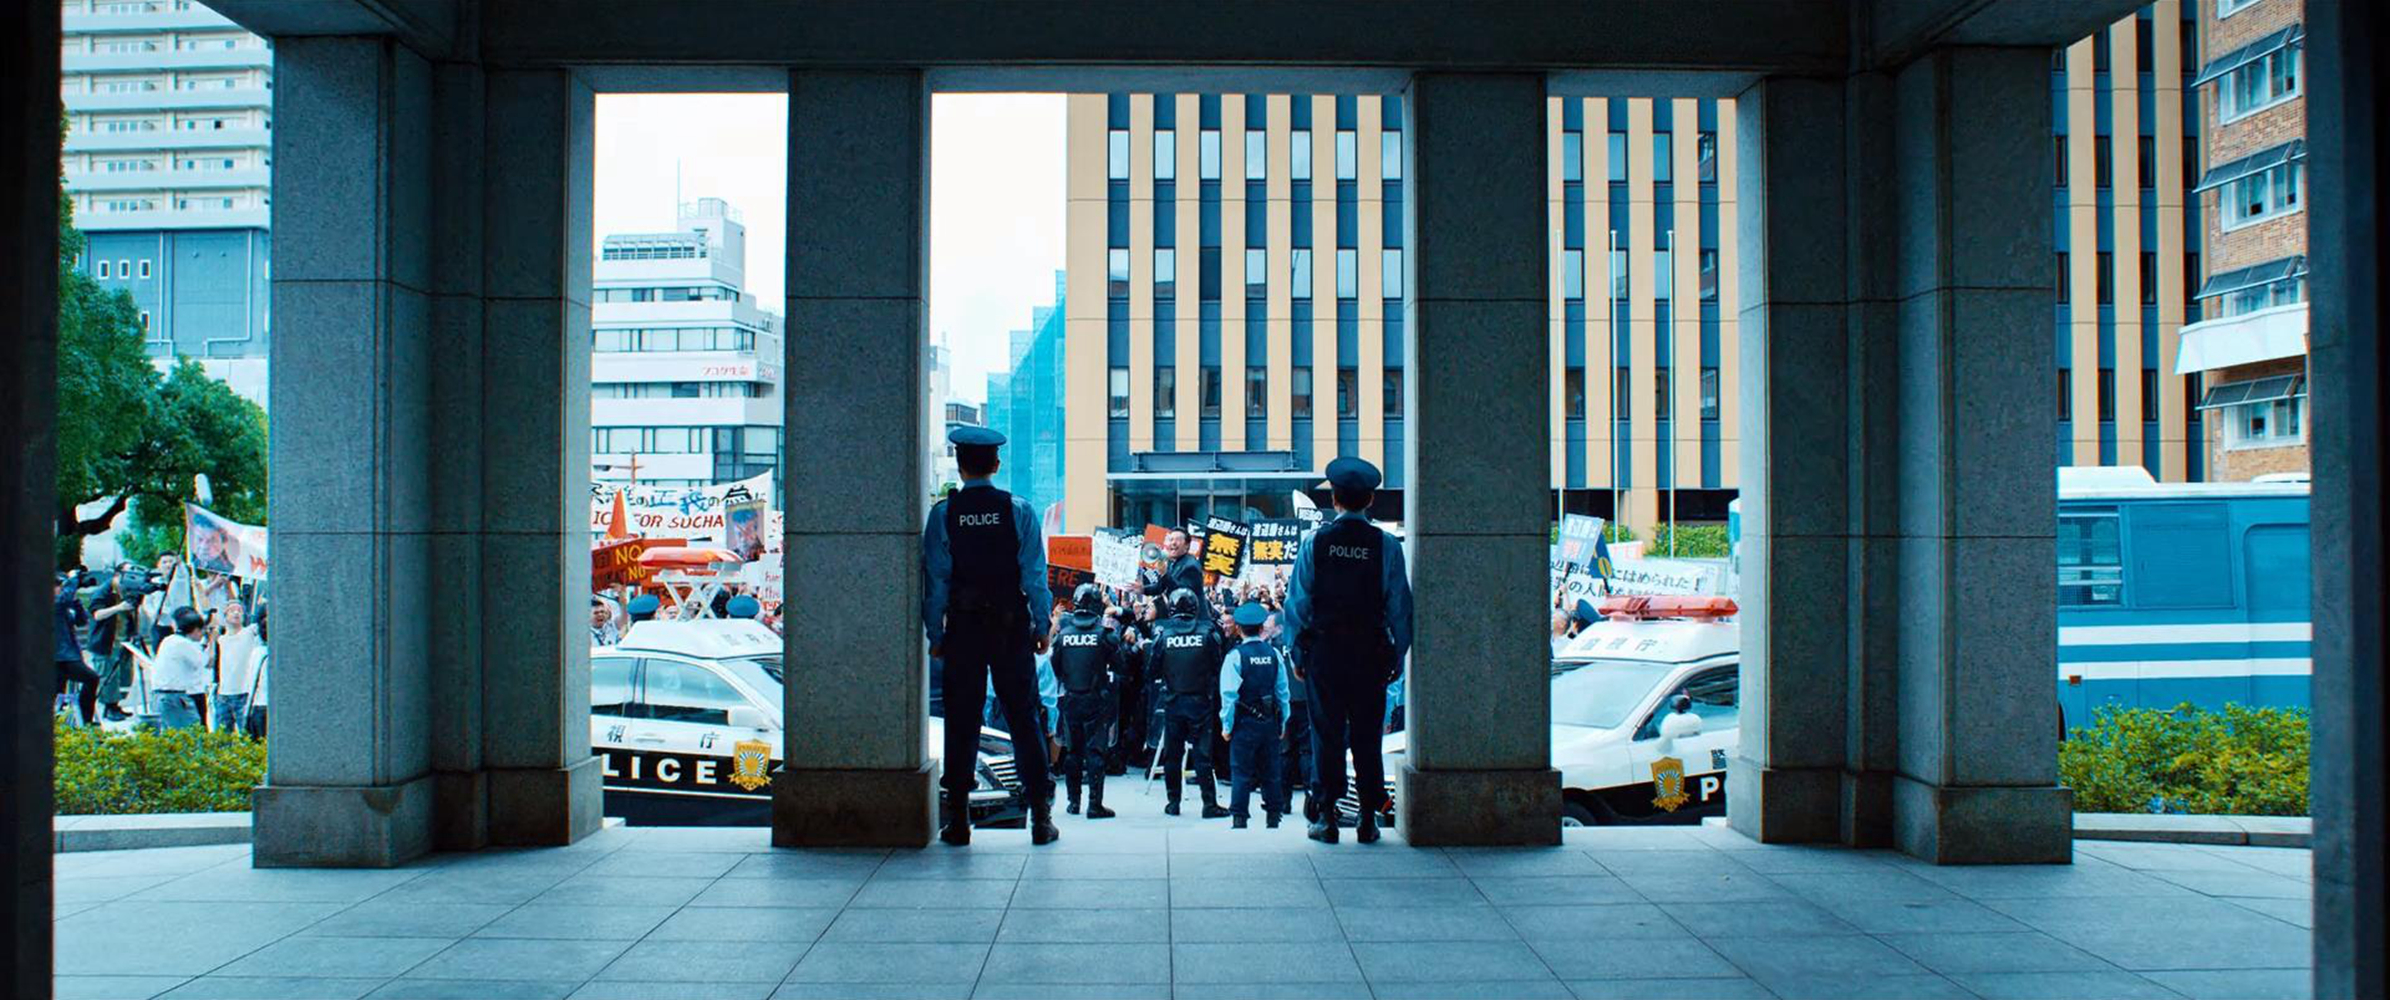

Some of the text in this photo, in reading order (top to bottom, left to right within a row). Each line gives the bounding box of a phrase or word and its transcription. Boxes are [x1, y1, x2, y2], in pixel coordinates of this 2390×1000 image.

[668, 515, 724, 529] SUCHA
[959, 513, 999, 526] POLICE
[615, 544, 642, 566] NO
[1253, 540, 1298, 561] 無実だ
[1328, 545, 1369, 560] POLICE
[1062, 634, 1098, 646] POLICE
[1166, 635, 1203, 648] POLICE
[1250, 656, 1272, 665] POLICE
[601, 753, 717, 784] LICE
[1700, 776, 1720, 801] P
